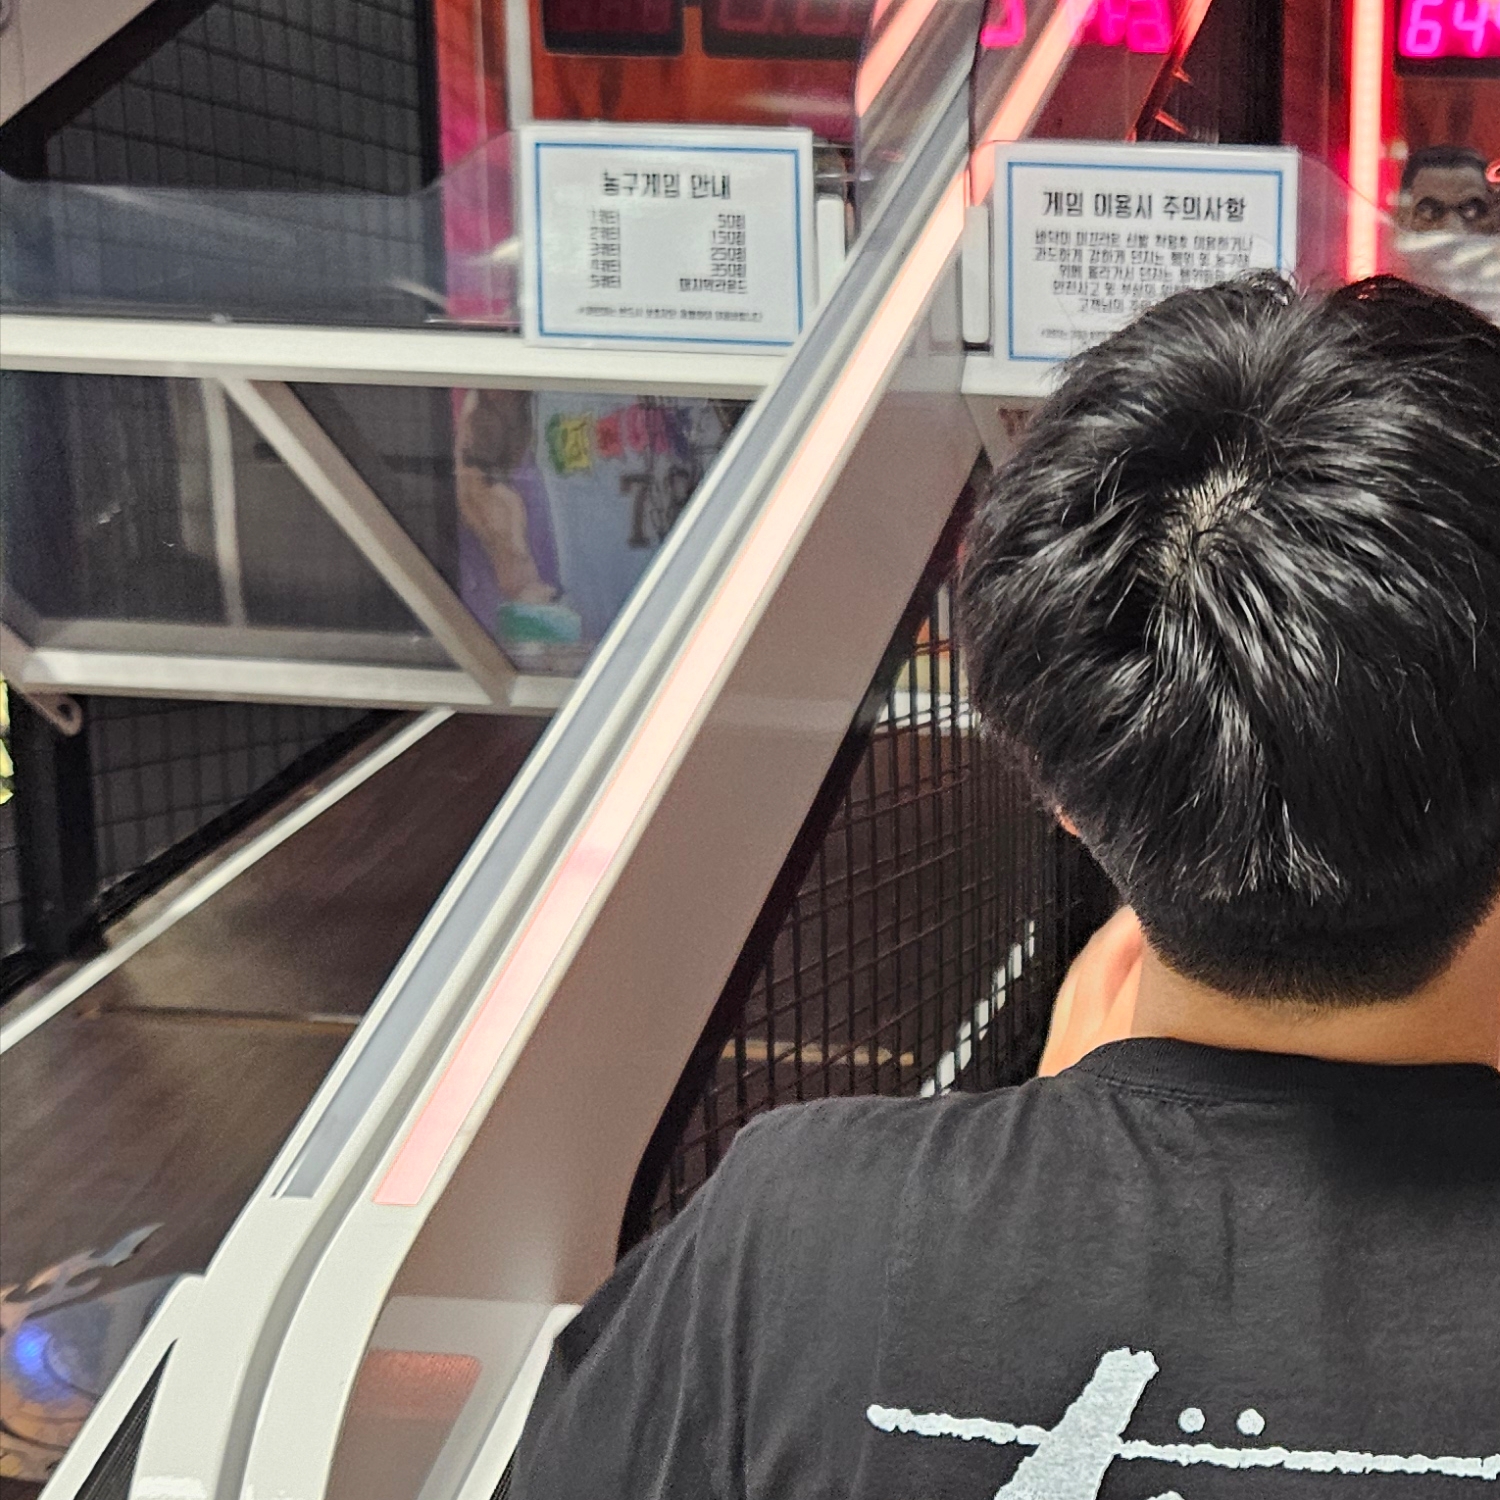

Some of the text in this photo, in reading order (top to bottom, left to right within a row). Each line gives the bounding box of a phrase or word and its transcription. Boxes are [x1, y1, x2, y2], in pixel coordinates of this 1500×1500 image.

[603, 168, 732, 200] 농구게임 안내
[1042, 191, 1248, 223] 게임 이용시 주의사항
